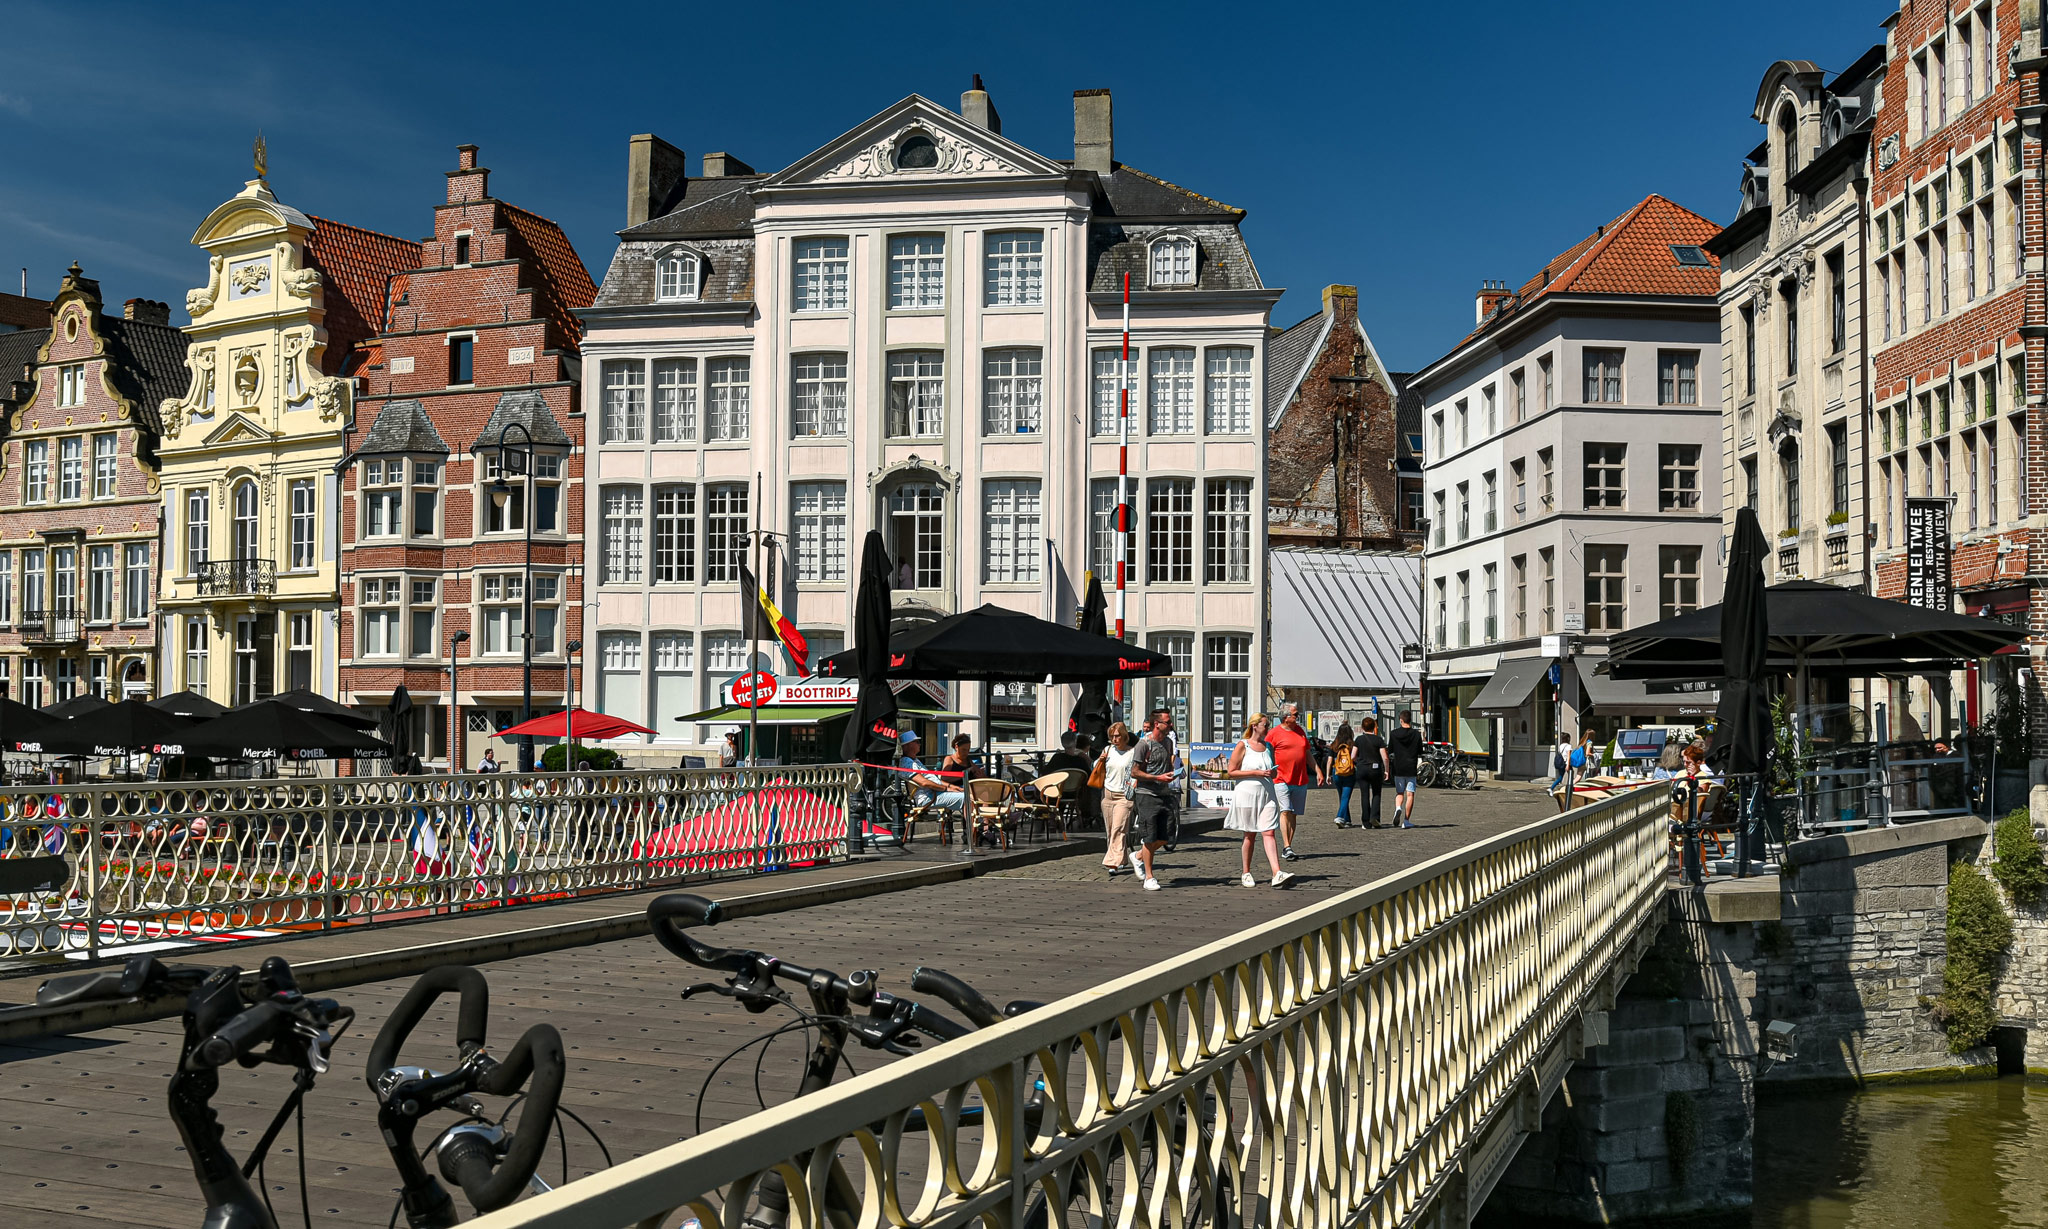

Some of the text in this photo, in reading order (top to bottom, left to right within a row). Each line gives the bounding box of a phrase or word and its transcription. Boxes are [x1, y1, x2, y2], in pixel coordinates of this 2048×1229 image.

[1910, 507, 1923, 549] TWEE
[1935, 508, 1945, 538] VIEW
[1925, 508, 1934, 566] RESTAURANT
[1936, 541, 1946, 549] A
[1936, 552, 1946, 583] WITH
[740, 674, 764, 688] HIR
[736, 686, 773, 704] TICETS
[786, 687, 852, 699] BOOTTRIPS
[94, 745, 126, 756] Meraki
[242, 747, 277, 758] Meraki
[353, 748, 388, 758] Meraki
